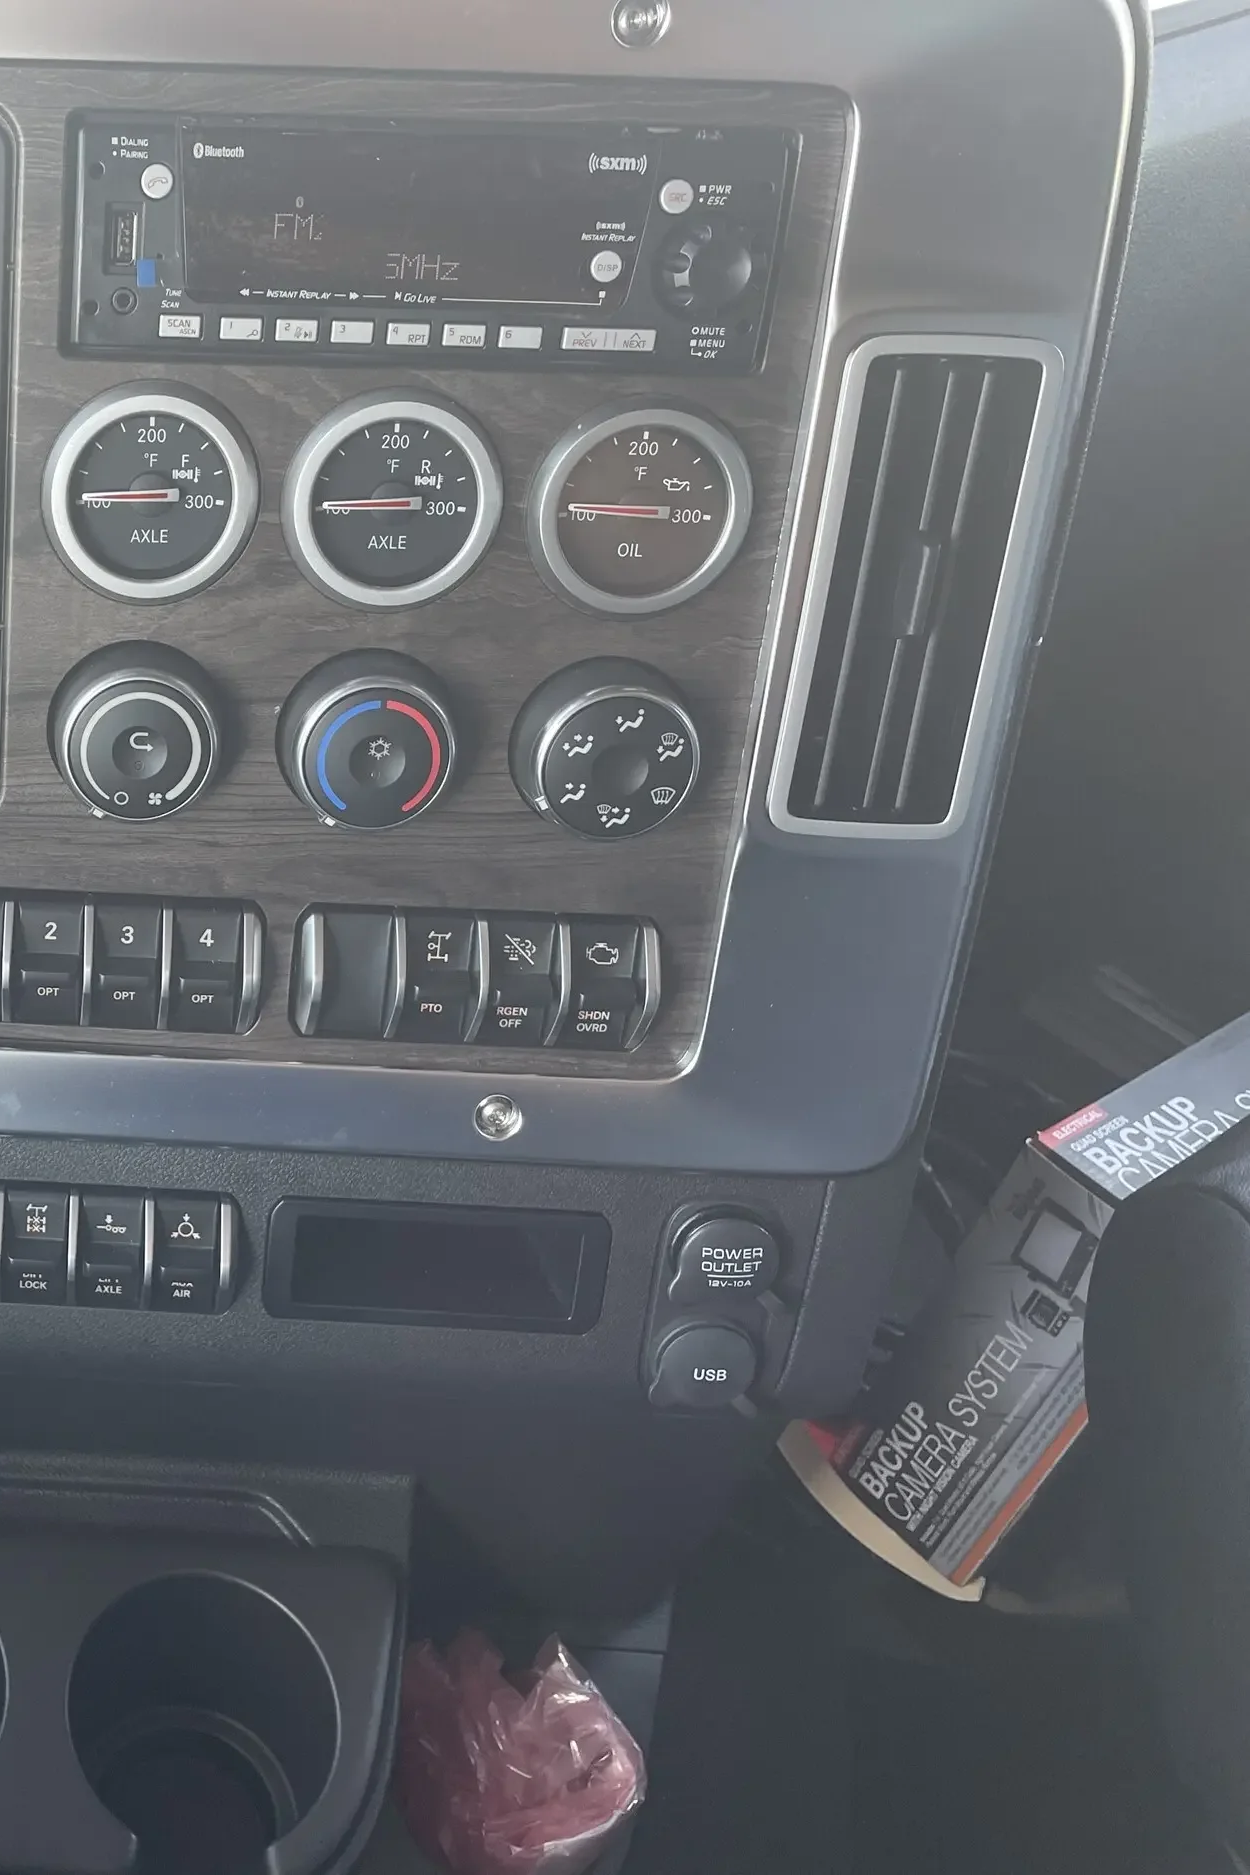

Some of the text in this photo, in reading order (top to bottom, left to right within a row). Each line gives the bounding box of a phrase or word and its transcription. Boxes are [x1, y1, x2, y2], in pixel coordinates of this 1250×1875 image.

[120, 136, 149, 147] DIALING
[120, 149, 149, 160] PAIRING
[204, 145, 245, 158] Bluetooth
[708, 184, 732, 194] PWR
[707, 196, 728, 206] ESC
[597, 264, 619, 272] DISP
[167, 319, 191, 328] SCAN
[339, 324, 346, 334] 3
[392, 326, 399, 335] 4
[448, 327, 455, 337] 5
[504, 329, 513, 339] 6
[700, 327, 726, 336] MUTE
[408, 334, 426, 344] RPT
[459, 335, 482, 345] RDM
[572, 338, 598, 348] PREV
[622, 339, 647, 348] NEXT
[698, 339, 726, 348] MENU
[703, 350, 718, 359] OK
[137, 428, 167, 443] 200
[381, 434, 410, 449] 200
[628, 441, 659, 456] 200
[181, 454, 190, 467] F
[421, 460, 431, 474] R
[184, 495, 214, 509] 300
[425, 501, 455, 516] 300
[671, 509, 701, 523] 300
[130, 529, 169, 544] AXLE
[367, 535, 407, 550] AXLE
[617, 543, 643, 558] OIL
[43, 921, 58, 941] 2
[119, 925, 135, 945] 3
[199, 928, 215, 947] 4
[36, 986, 60, 998] OPT
[112, 991, 136, 1002] OPT
[191, 993, 215, 1005] OPT
[420, 1002, 443, 1014] PTO
[496, 1006, 528, 1018] RGEN
[577, 1010, 611, 1022] SHDN
[499, 1018, 523, 1029] OFF
[576, 1022, 609, 1034] OVRD
[1083, 1096, 1199, 1175] BACKUP
[701, 1247, 764, 1260] POWER
[701, 1261, 763, 1274] OUTLET
[19, 1280, 48, 1291] LOCK
[707, 1279, 752, 1287] 12V-10A
[94, 1285, 123, 1294] AXLE
[172, 1289, 192, 1298] AIR
[693, 1367, 728, 1381] USB
[884, 1421, 966, 1521] CAMERA
[948, 1319, 1034, 1428] SYSTEM
[859, 1401, 929, 1499] BACKUP
